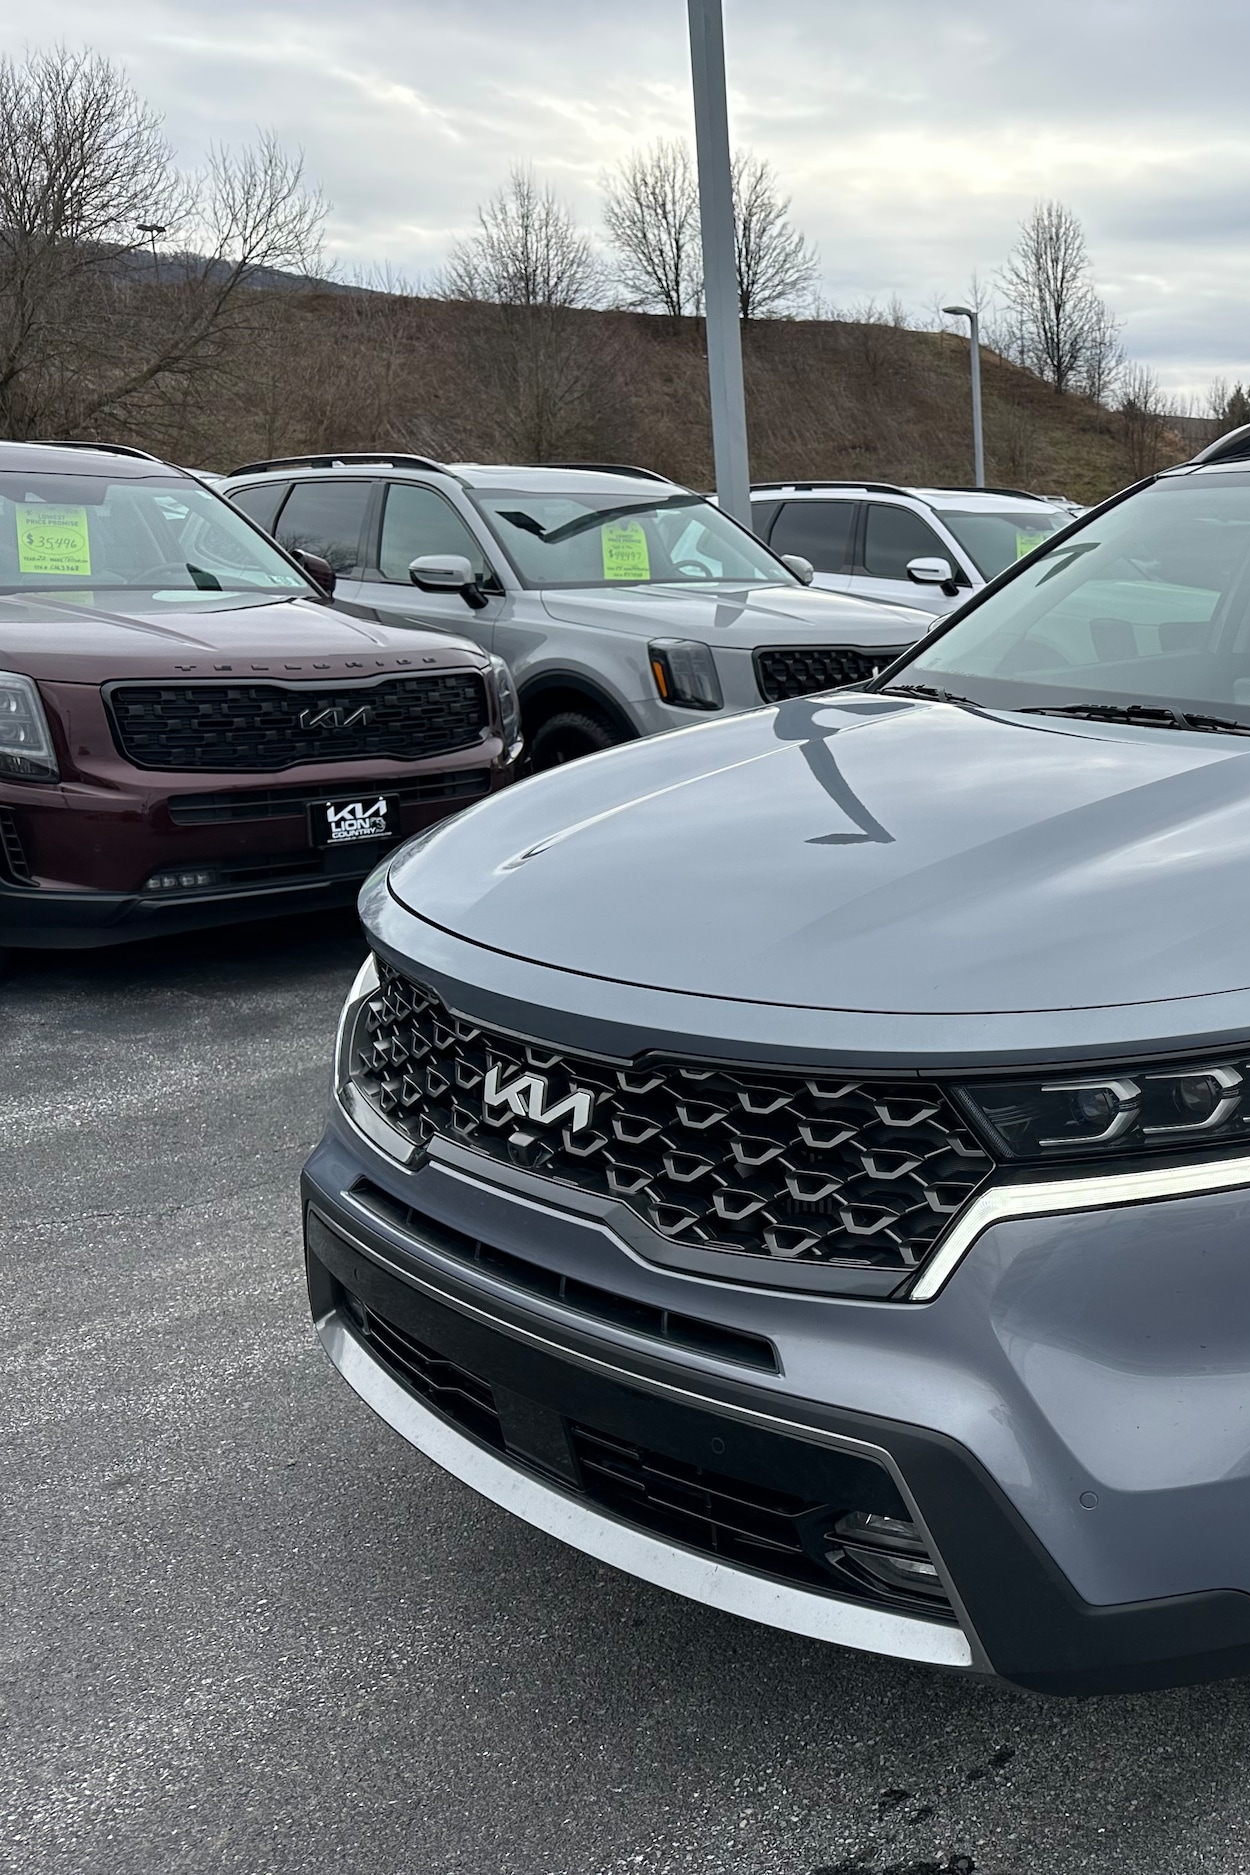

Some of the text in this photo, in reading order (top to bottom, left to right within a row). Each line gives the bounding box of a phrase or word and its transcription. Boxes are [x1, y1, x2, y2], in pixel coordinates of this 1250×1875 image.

[25, 518, 79, 527] PRICE PROMISE
[174, 656, 437, 672] TELLURIDE
[298, 705, 371, 730] KIA
[326, 798, 388, 823] KIA
[330, 817, 370, 832] LION
[331, 826, 377, 839] COUNTRY
[483, 1061, 594, 1134] KIA
